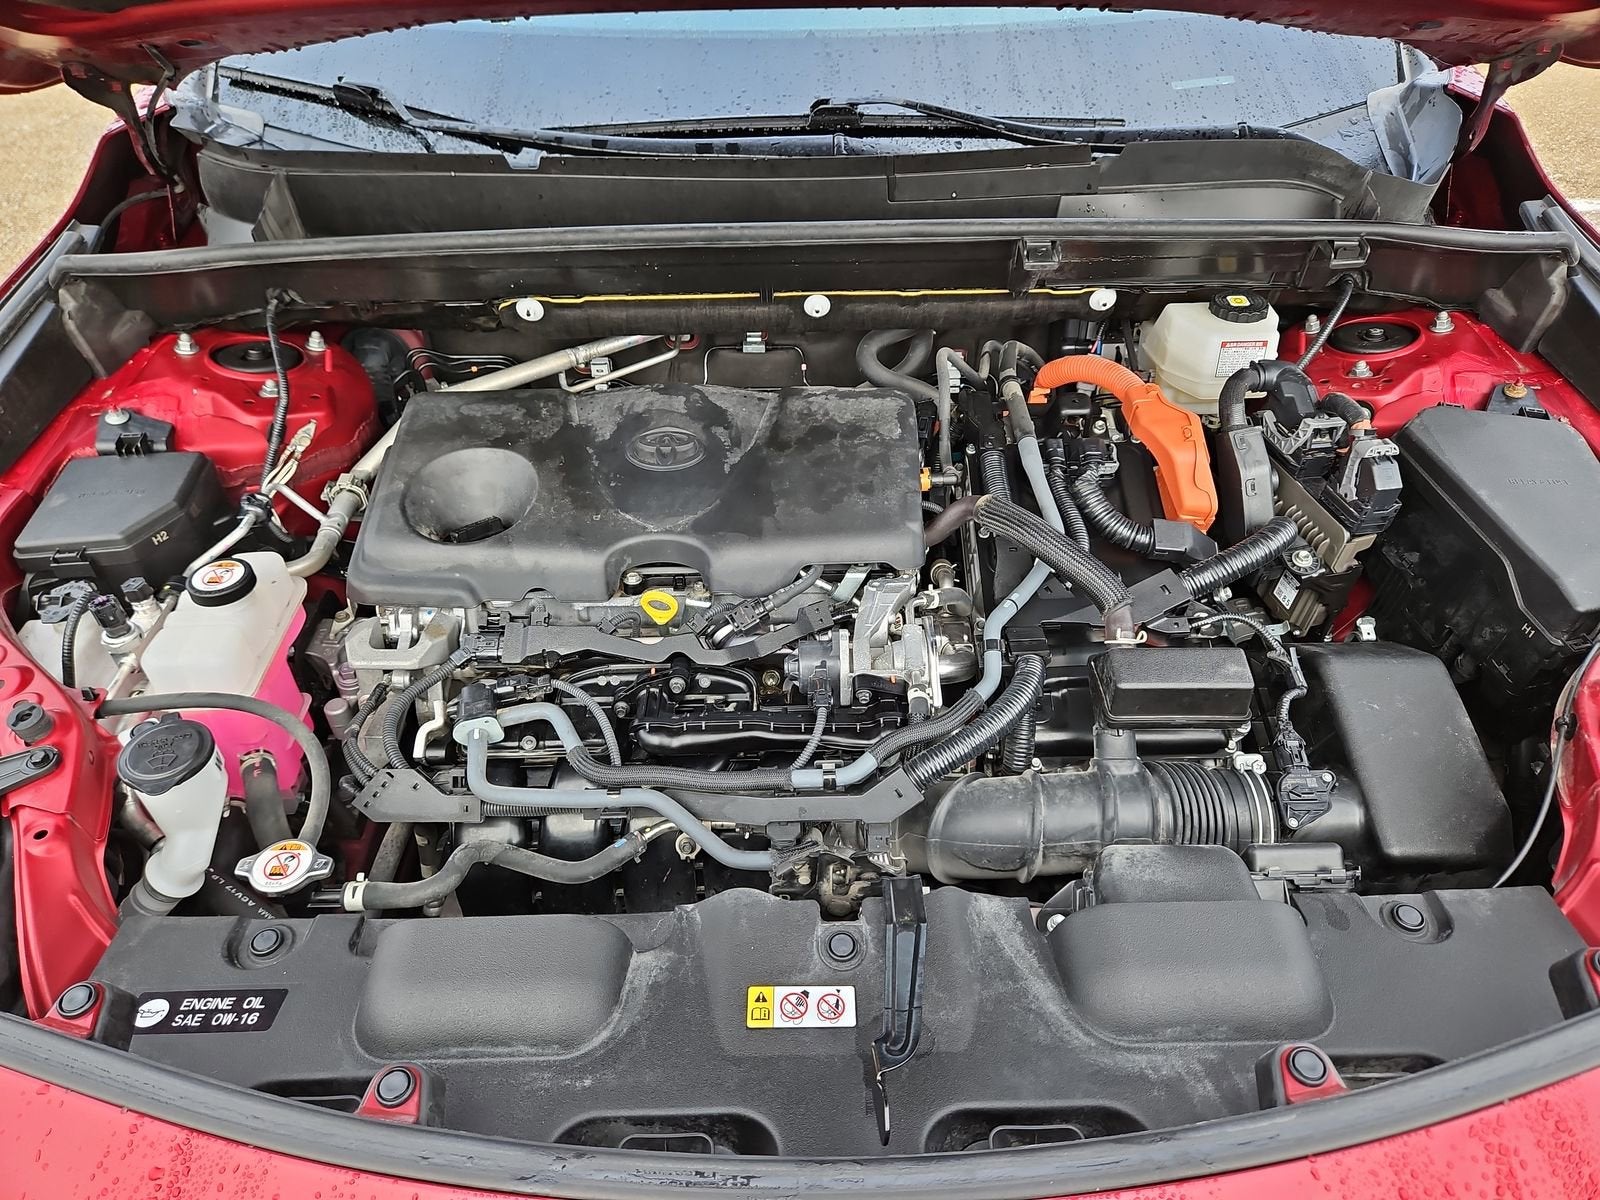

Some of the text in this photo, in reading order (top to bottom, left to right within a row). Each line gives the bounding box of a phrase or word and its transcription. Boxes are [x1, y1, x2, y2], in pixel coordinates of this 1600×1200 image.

[151, 531, 169, 545] H2
[1521, 622, 1536, 638] H1
[179, 996, 265, 1010] ENGINE OIL
[171, 1012, 260, 1027] SAE 0W-16
